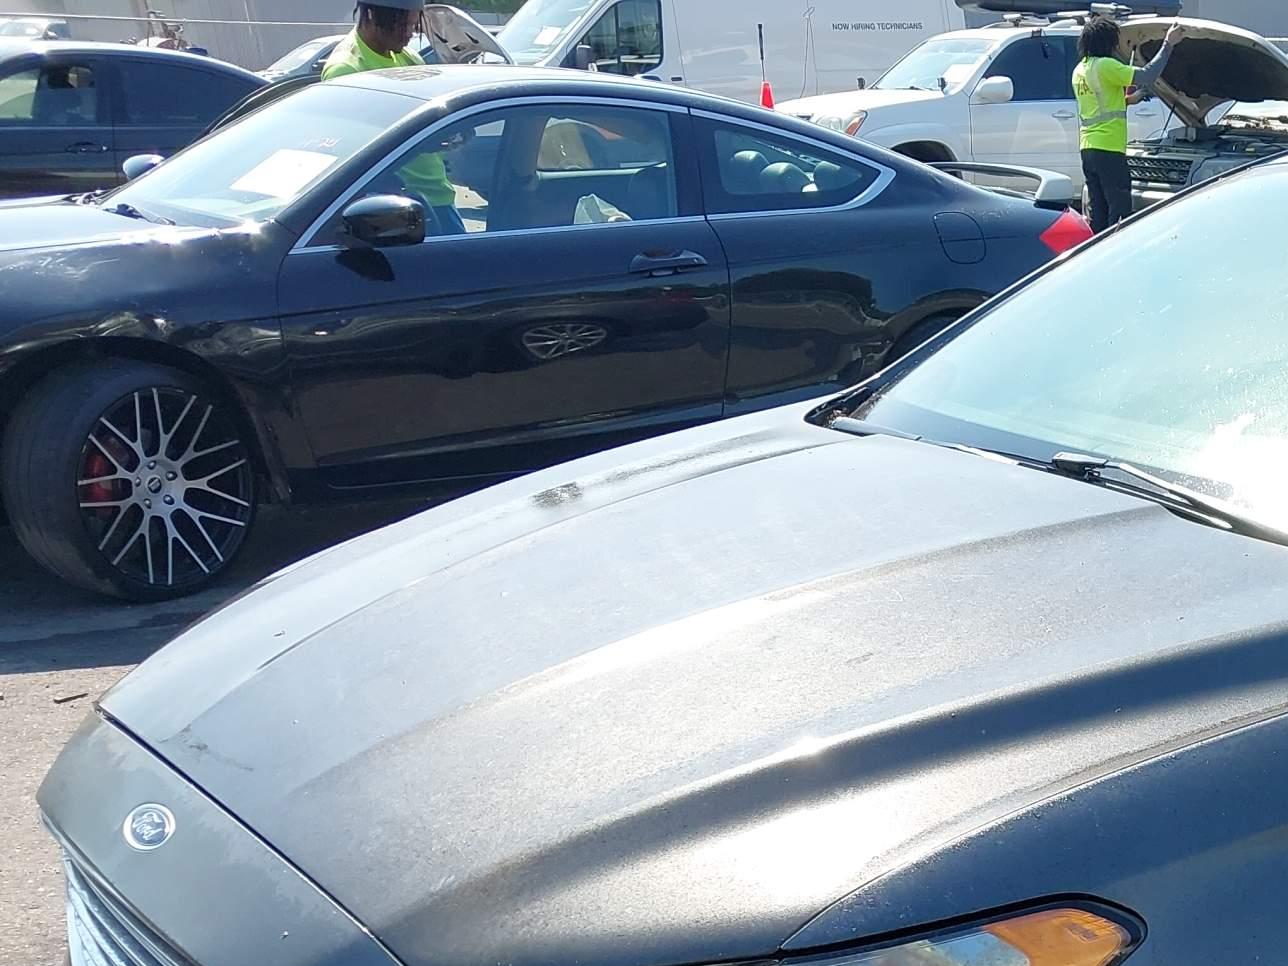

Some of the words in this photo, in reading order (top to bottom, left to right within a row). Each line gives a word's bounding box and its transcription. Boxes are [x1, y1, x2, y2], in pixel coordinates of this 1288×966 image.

[831, 22, 850, 31] NOW
[851, 22, 876, 31] HIRING
[877, 22, 923, 30] TECHNICIANS
